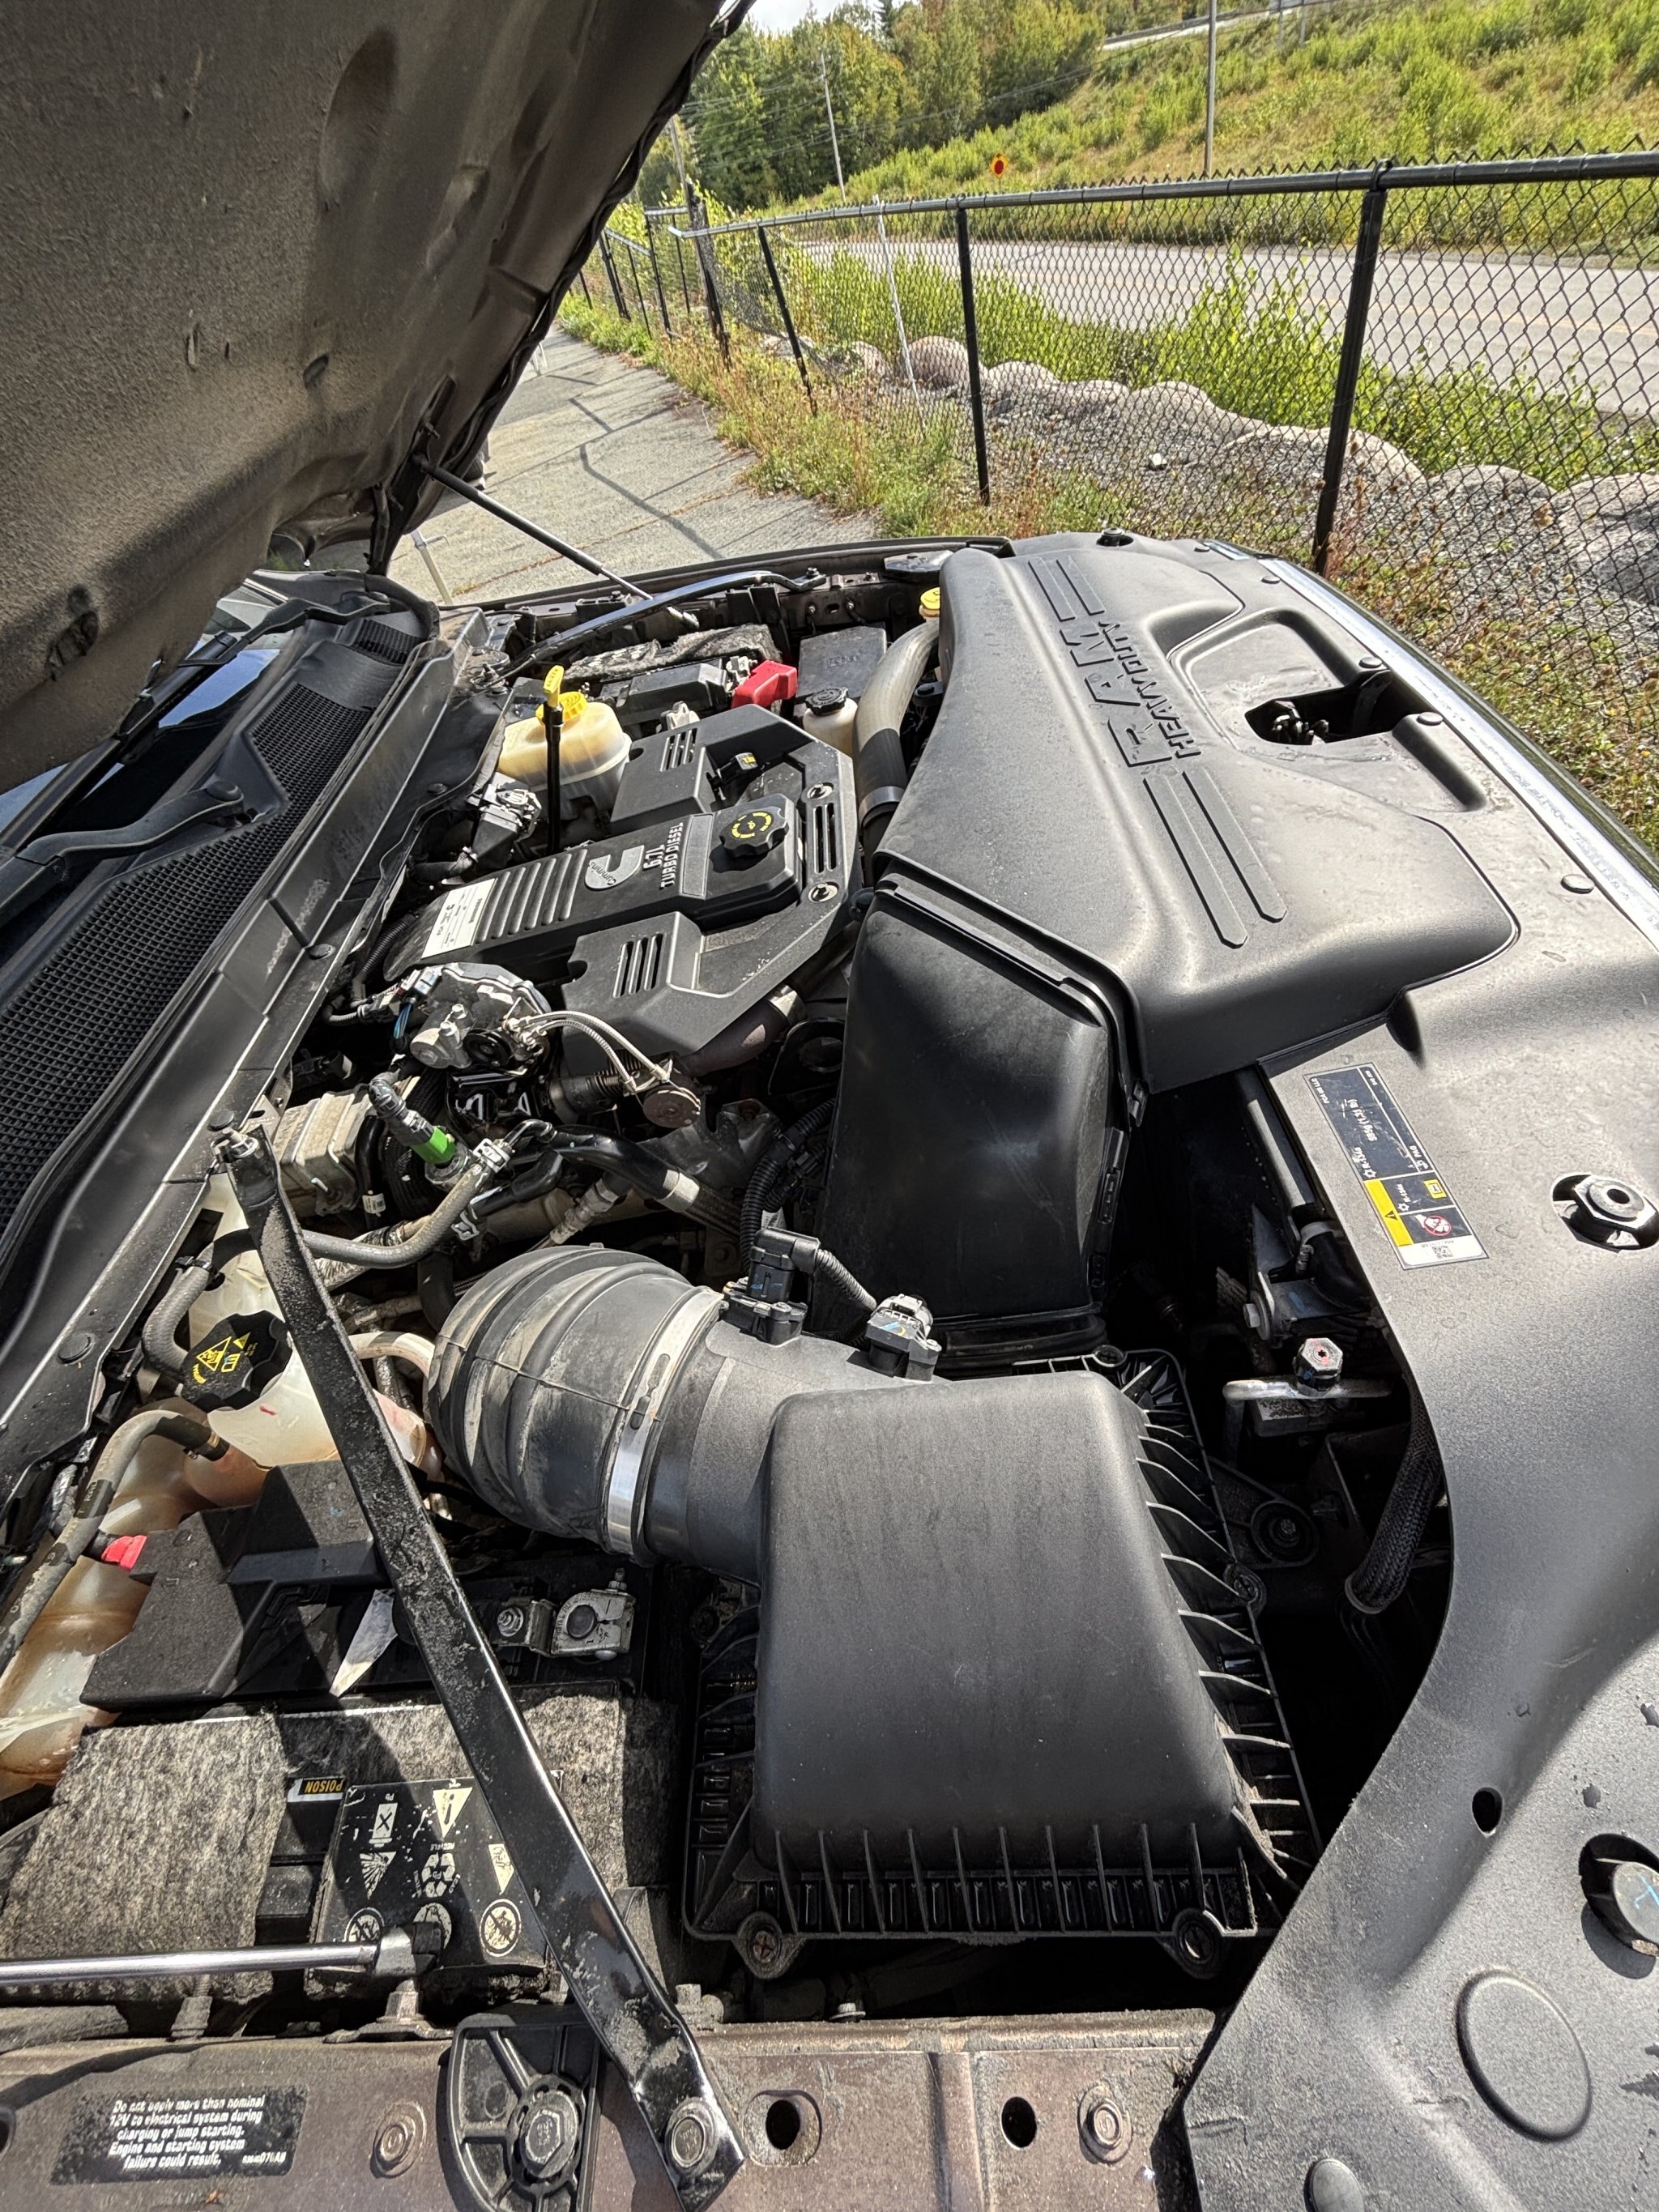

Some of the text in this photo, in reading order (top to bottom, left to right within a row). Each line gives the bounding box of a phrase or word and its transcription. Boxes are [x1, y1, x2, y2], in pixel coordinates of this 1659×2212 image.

[1060, 629, 1173, 767] RAM
[1098, 621, 1201, 759] HEAVY DUTY
[659, 821, 684, 890] TURBO DIESEL
[588, 861, 617, 886] Cummins
[1311, 1078, 1321, 1089] LLC
[1354, 1147, 1371, 1169] R-134a
[1409, 1145, 1422, 1157] PAG
[304, 1779, 344, 1793] POISON
[385, 1792, 395, 1801] Pb
[432, 1871, 442, 1880] Pb
[113, 2100, 127, 2113] Do
[227, 2095, 266, 2108] nominal
[109, 2110, 263, 2127] 12V to electrical system during
[117, 2128, 159, 2142] charging
[161, 2128, 174, 2138] or
[174, 2125, 199, 2140] jump
[108, 2138, 246, 2157] Engine and starting system
[124, 2154, 158, 2169] failure
[159, 2153, 187, 2167] could
